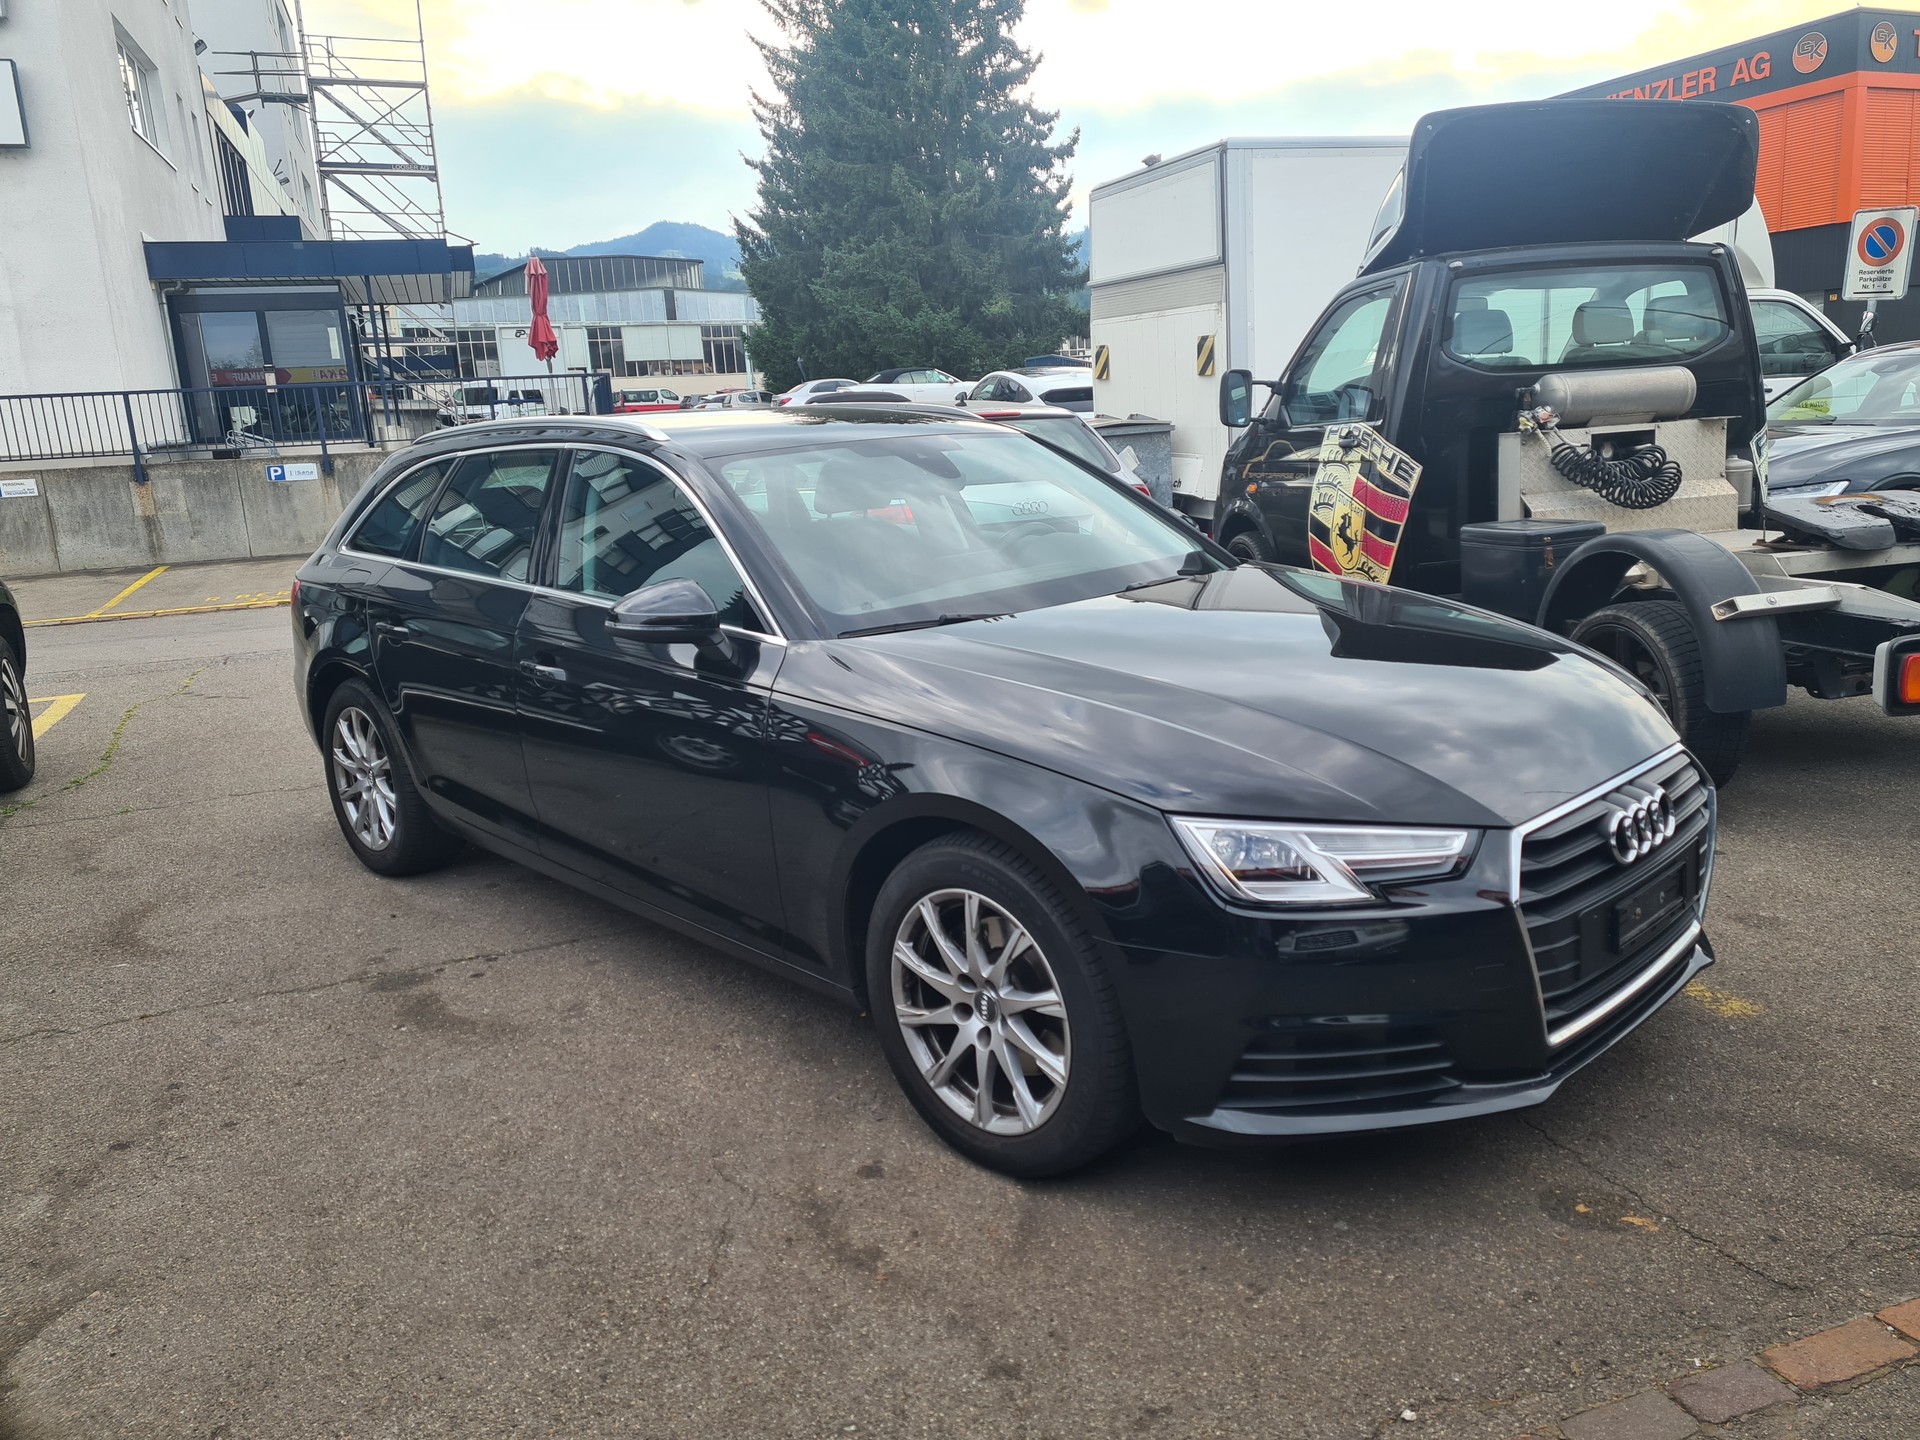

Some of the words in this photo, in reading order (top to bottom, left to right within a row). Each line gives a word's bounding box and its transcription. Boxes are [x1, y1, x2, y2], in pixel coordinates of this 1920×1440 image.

[1730, 51, 1771, 87] AG
[1858, 275, 1892, 283] Parkplätze
[270, 466, 282, 480] P
